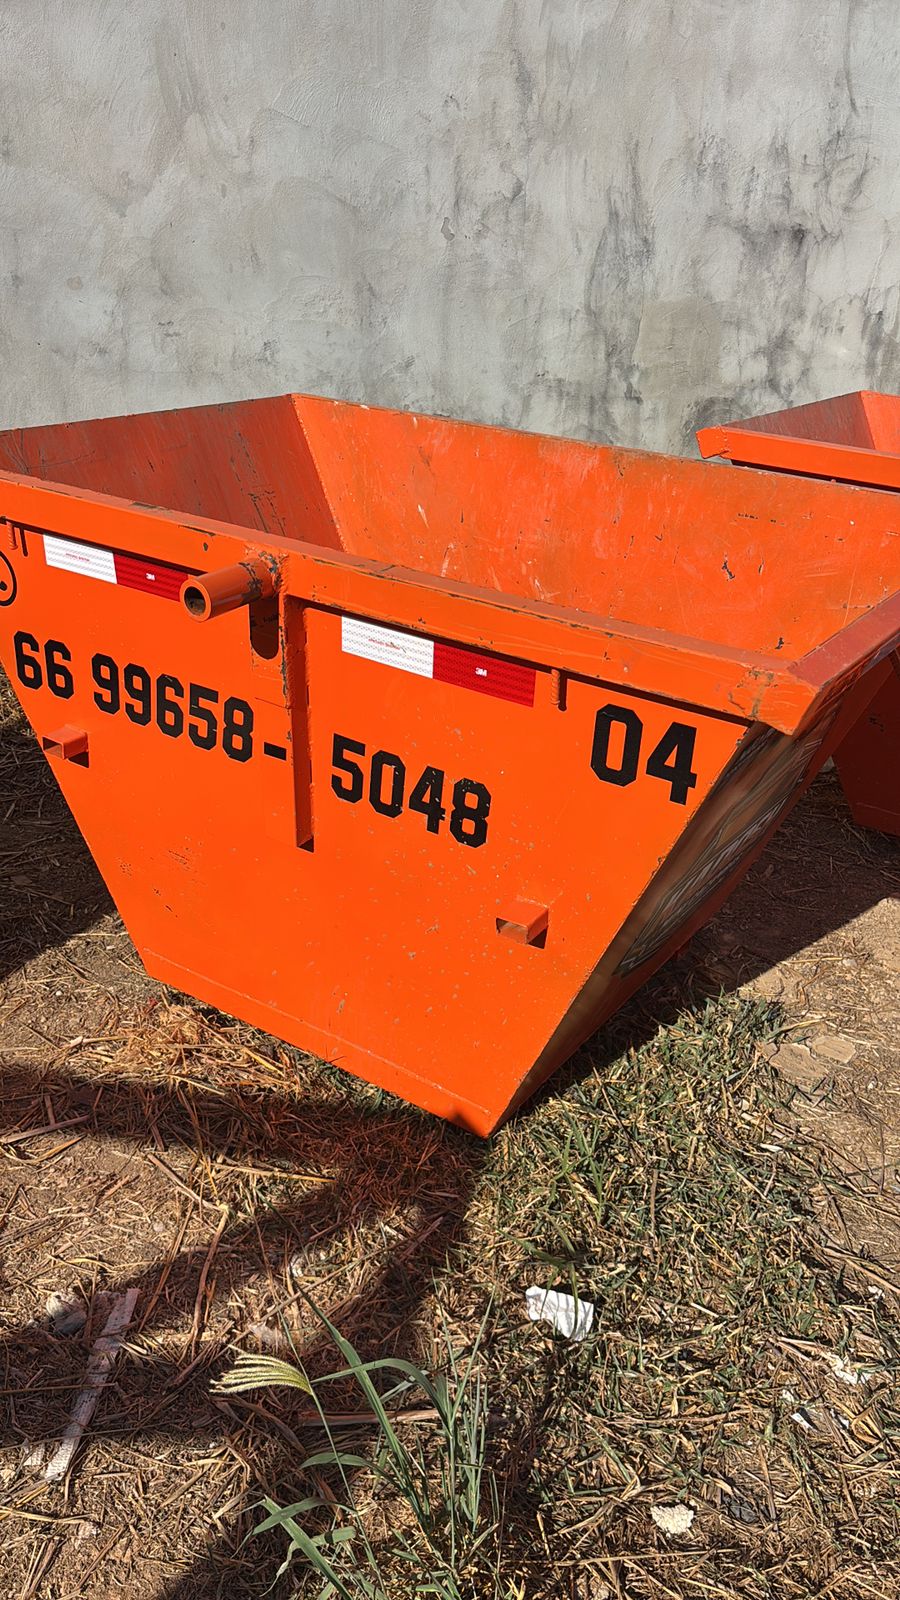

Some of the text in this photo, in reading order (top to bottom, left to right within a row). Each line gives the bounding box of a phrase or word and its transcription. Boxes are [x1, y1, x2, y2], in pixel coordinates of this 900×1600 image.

[475, 667, 488, 677] 3M
[13, 630, 75, 700] 66
[331, 733, 492, 849] 5048
[590, 703, 698, 806] 04
